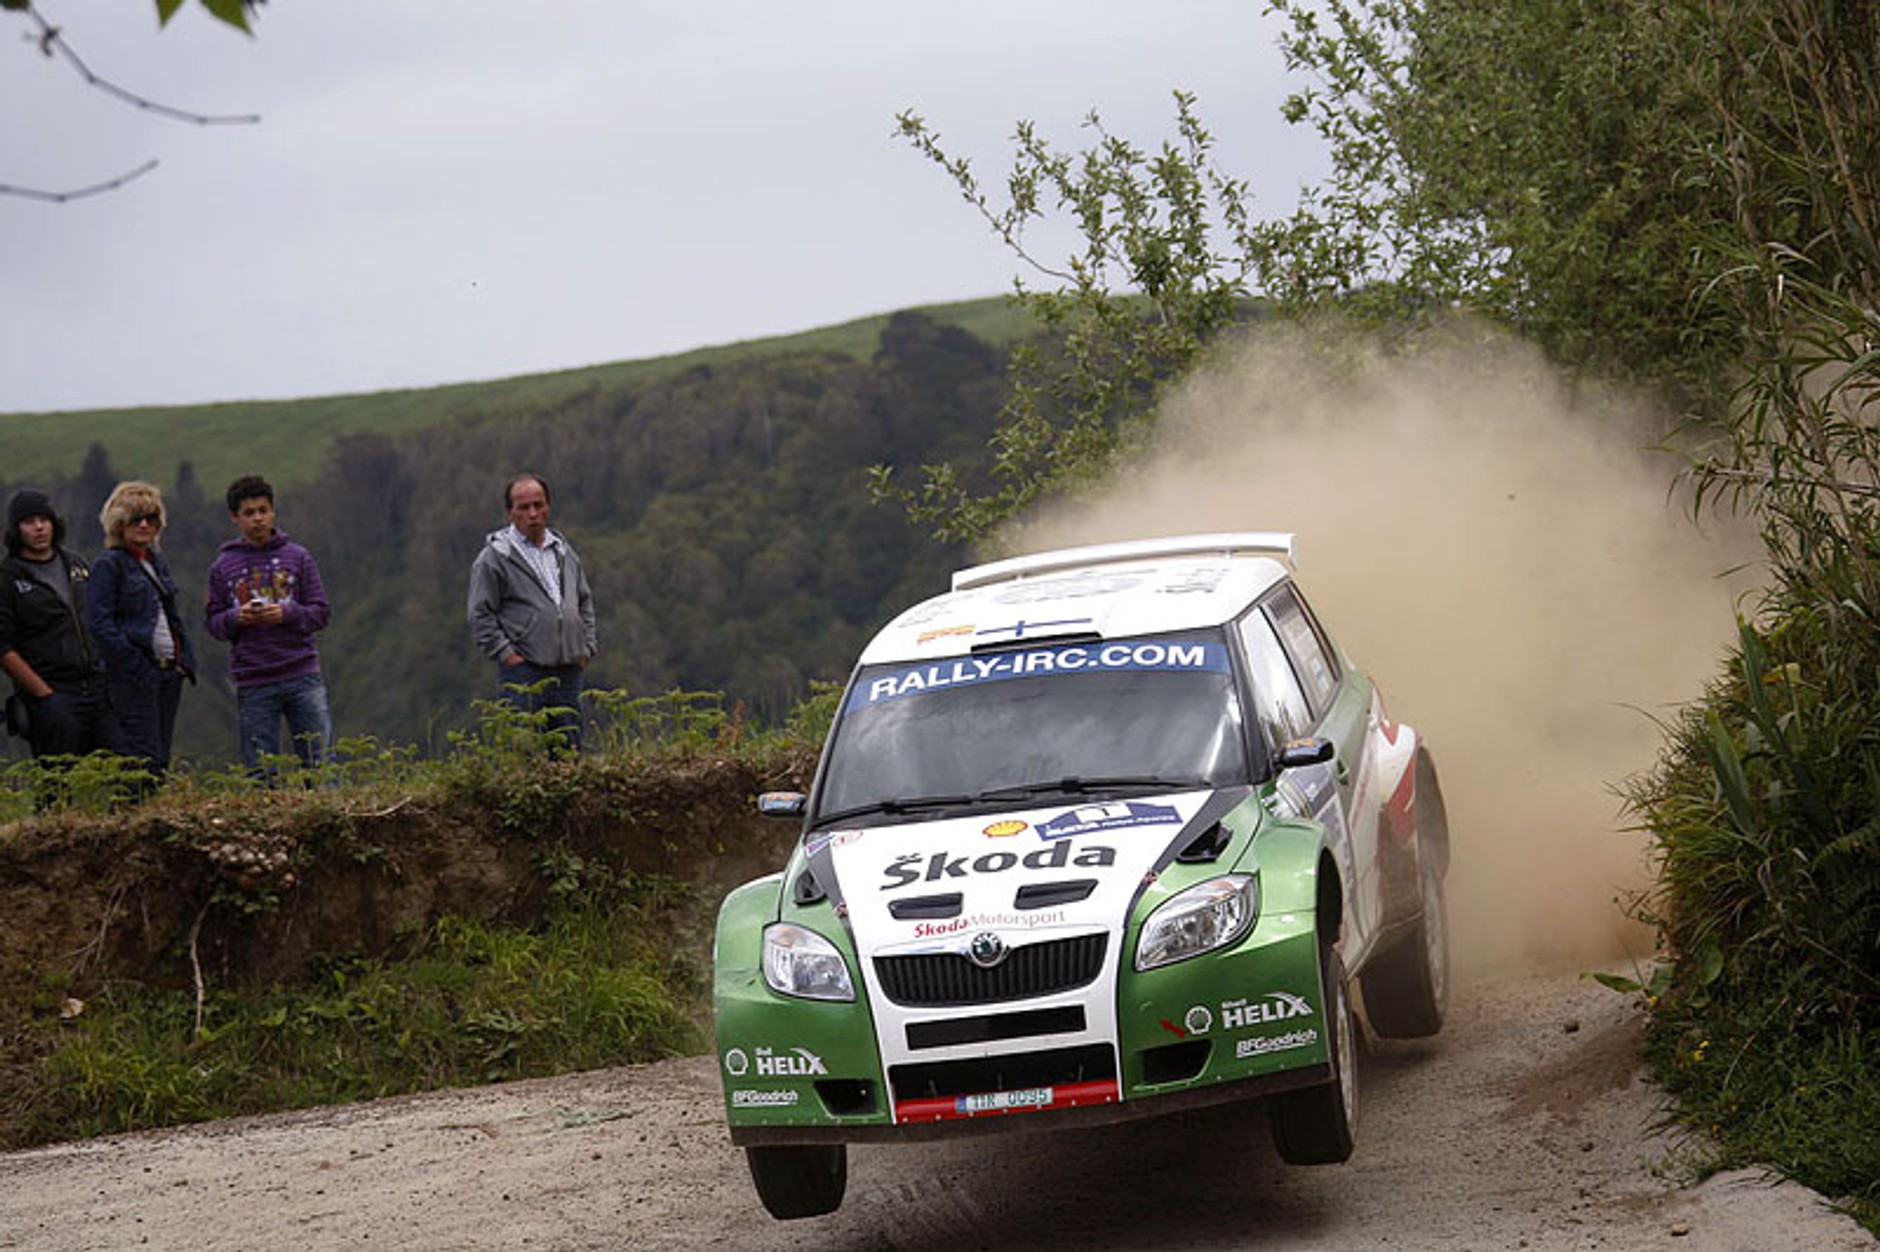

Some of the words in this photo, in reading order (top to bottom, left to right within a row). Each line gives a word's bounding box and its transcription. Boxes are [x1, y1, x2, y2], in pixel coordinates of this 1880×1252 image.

[869, 645, 1205, 701] RALLY-IRC.COM
[879, 839, 1117, 891] Škoda
[1221, 991, 1313, 1029] HELIX
[755, 1047, 829, 1075] HELIX
